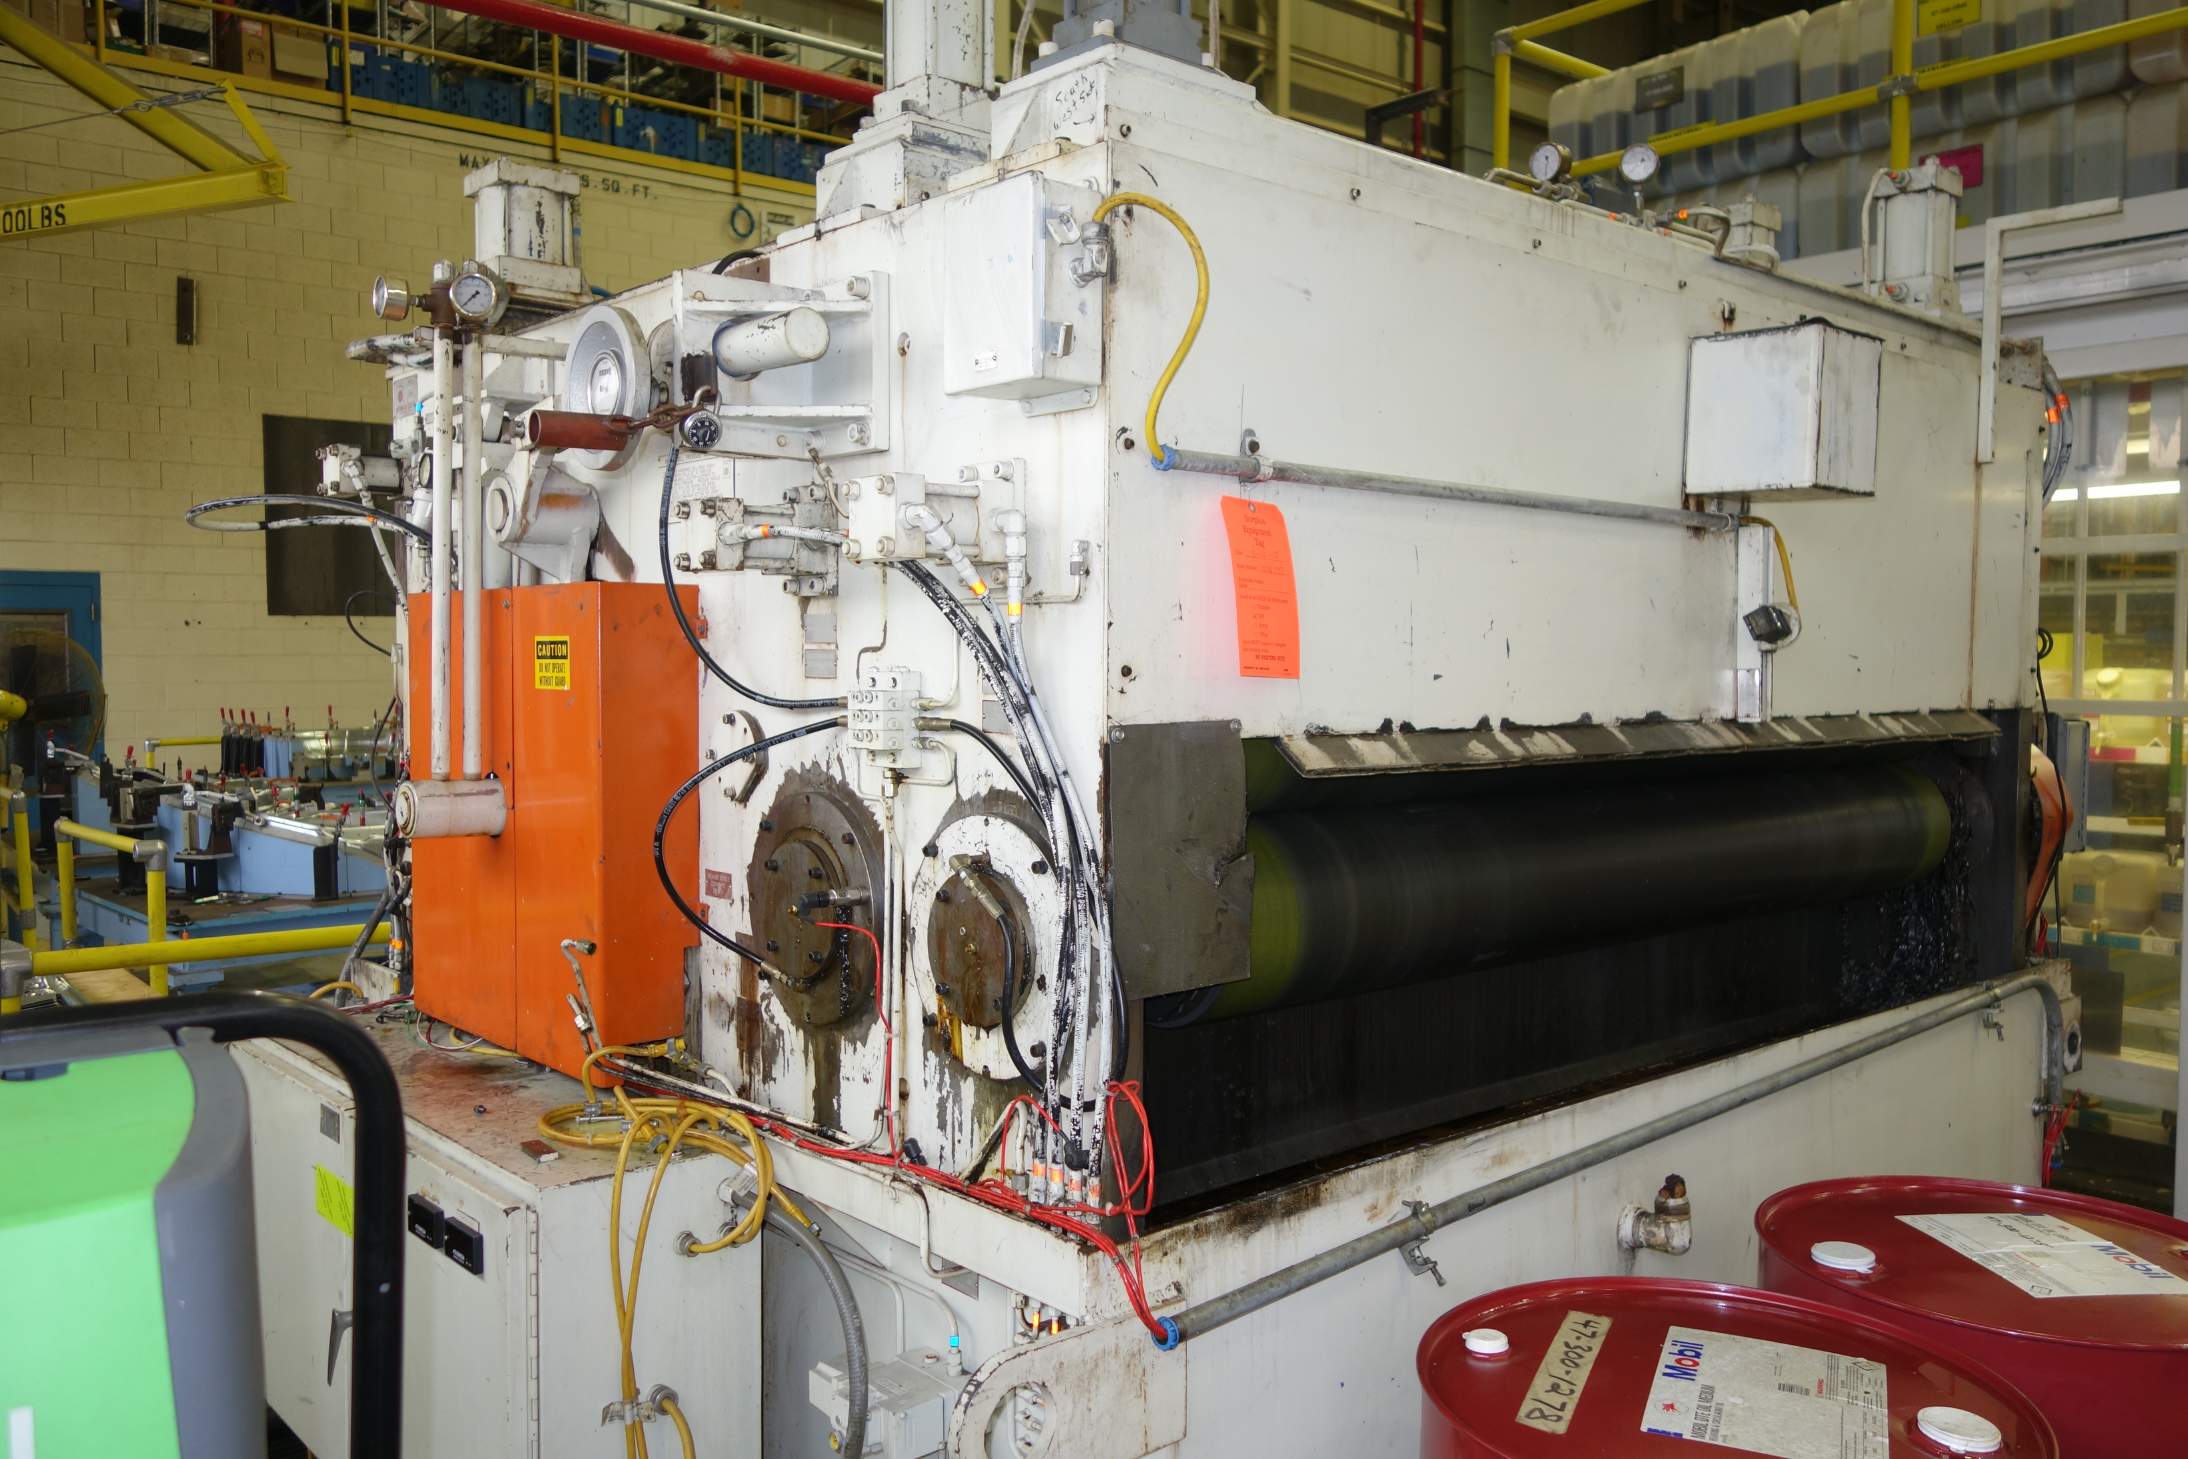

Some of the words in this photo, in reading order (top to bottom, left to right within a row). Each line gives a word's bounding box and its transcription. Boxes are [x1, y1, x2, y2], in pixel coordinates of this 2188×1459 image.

[537, 644, 567, 657] CAUTION
[2089, 1245, 2175, 1278] Mobil
[1662, 1340, 1704, 1381] Mobil
